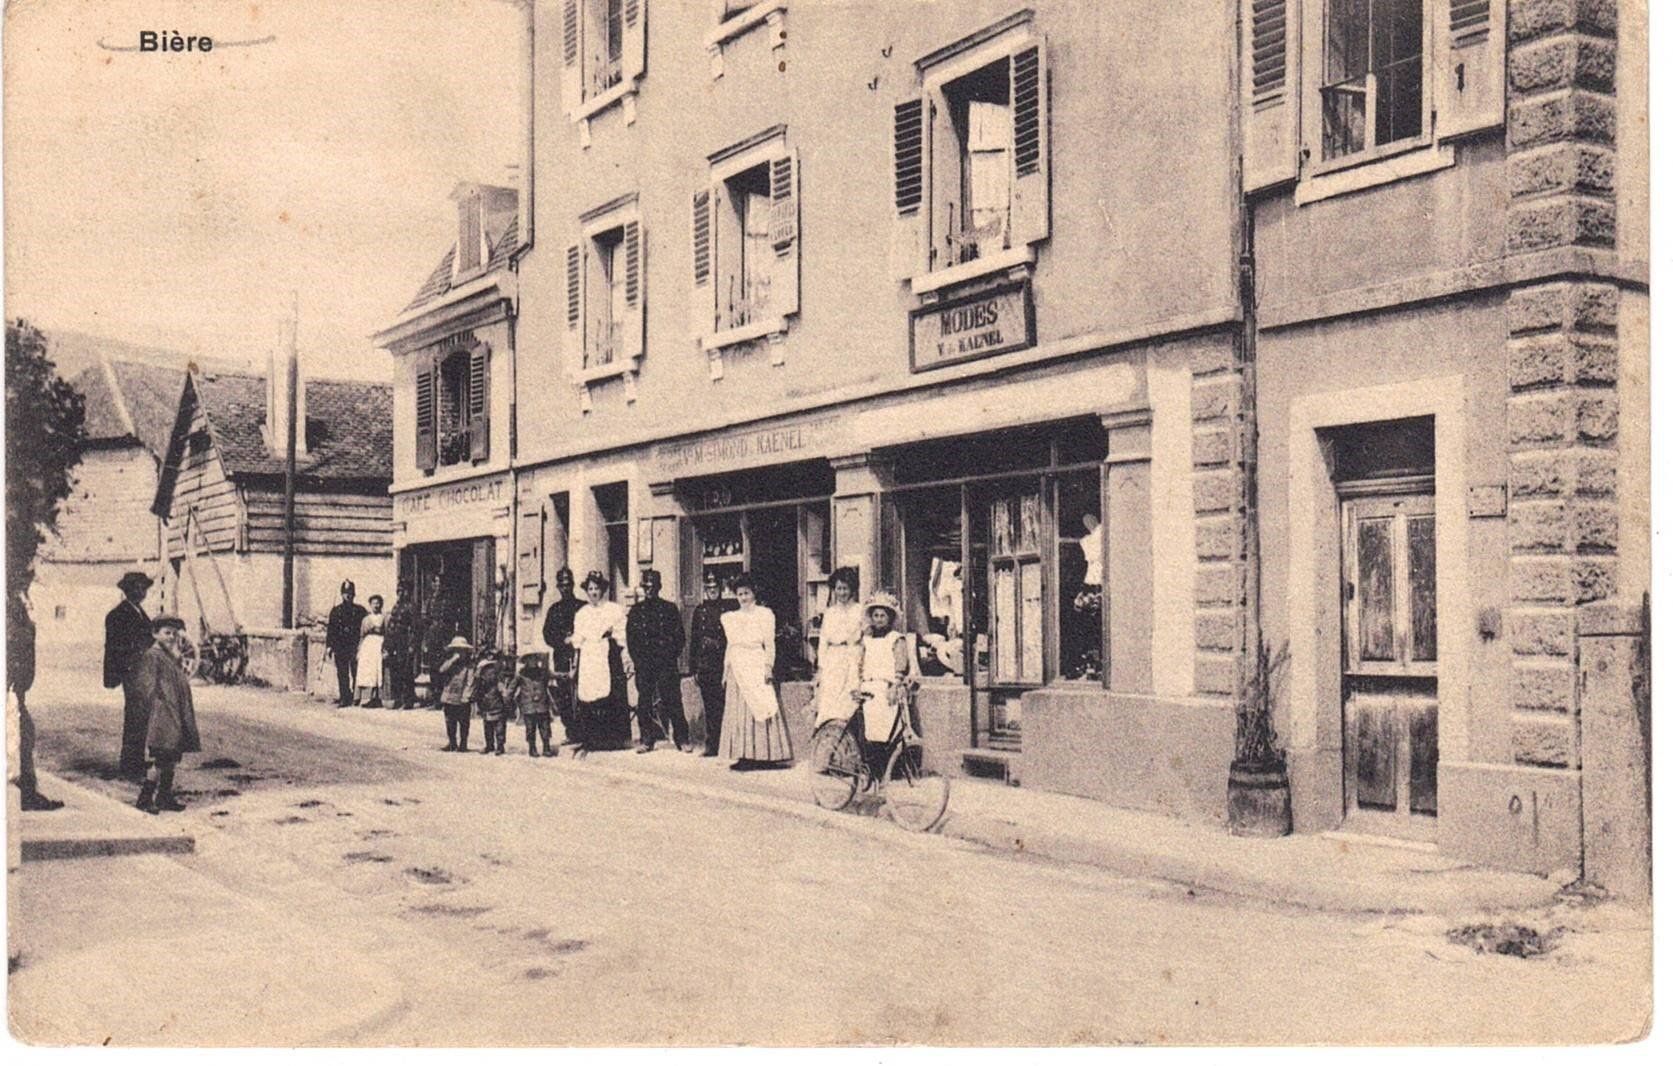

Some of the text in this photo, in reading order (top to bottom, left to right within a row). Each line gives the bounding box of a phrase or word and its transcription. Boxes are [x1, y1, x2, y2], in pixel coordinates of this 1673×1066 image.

[940, 300, 998, 337] MODES
[756, 429, 807, 452] KAENEL
[439, 481, 503, 507] CHOCOLAT
